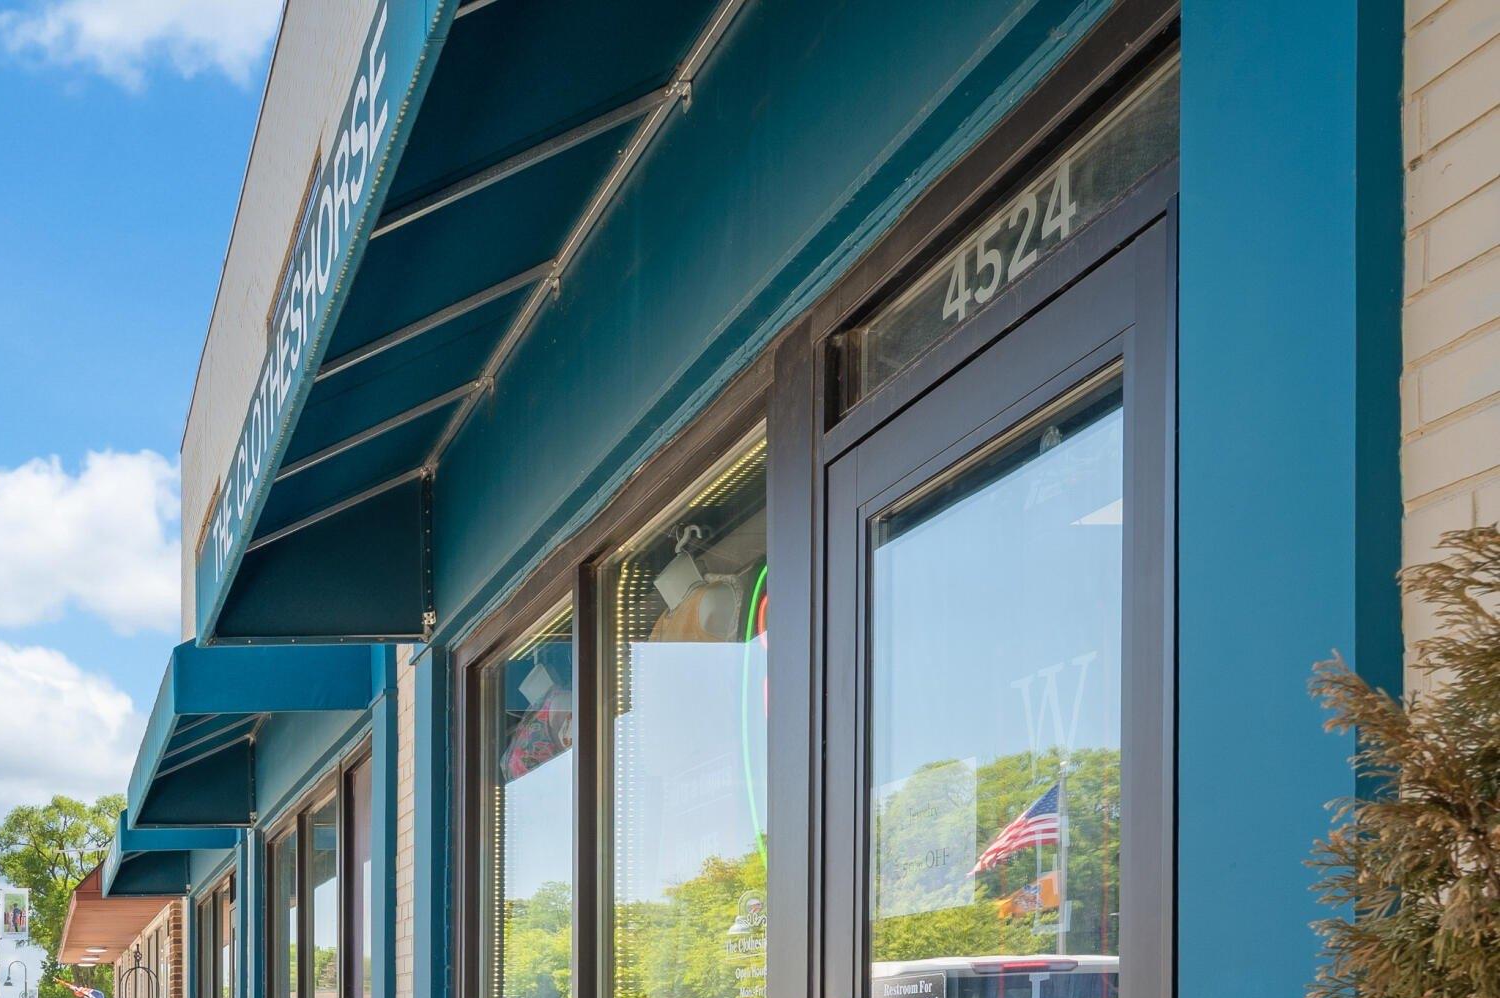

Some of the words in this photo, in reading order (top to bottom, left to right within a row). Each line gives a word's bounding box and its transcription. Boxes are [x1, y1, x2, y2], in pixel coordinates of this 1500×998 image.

[942, 160, 1077, 323] 4524
[213, 479, 235, 583] THE
[236, 1, 388, 521] CLOTHESHORSE
[925, 847, 950, 869] OFF
[883, 983, 918, 996] Restroom
[919, 980, 933, 993] For
